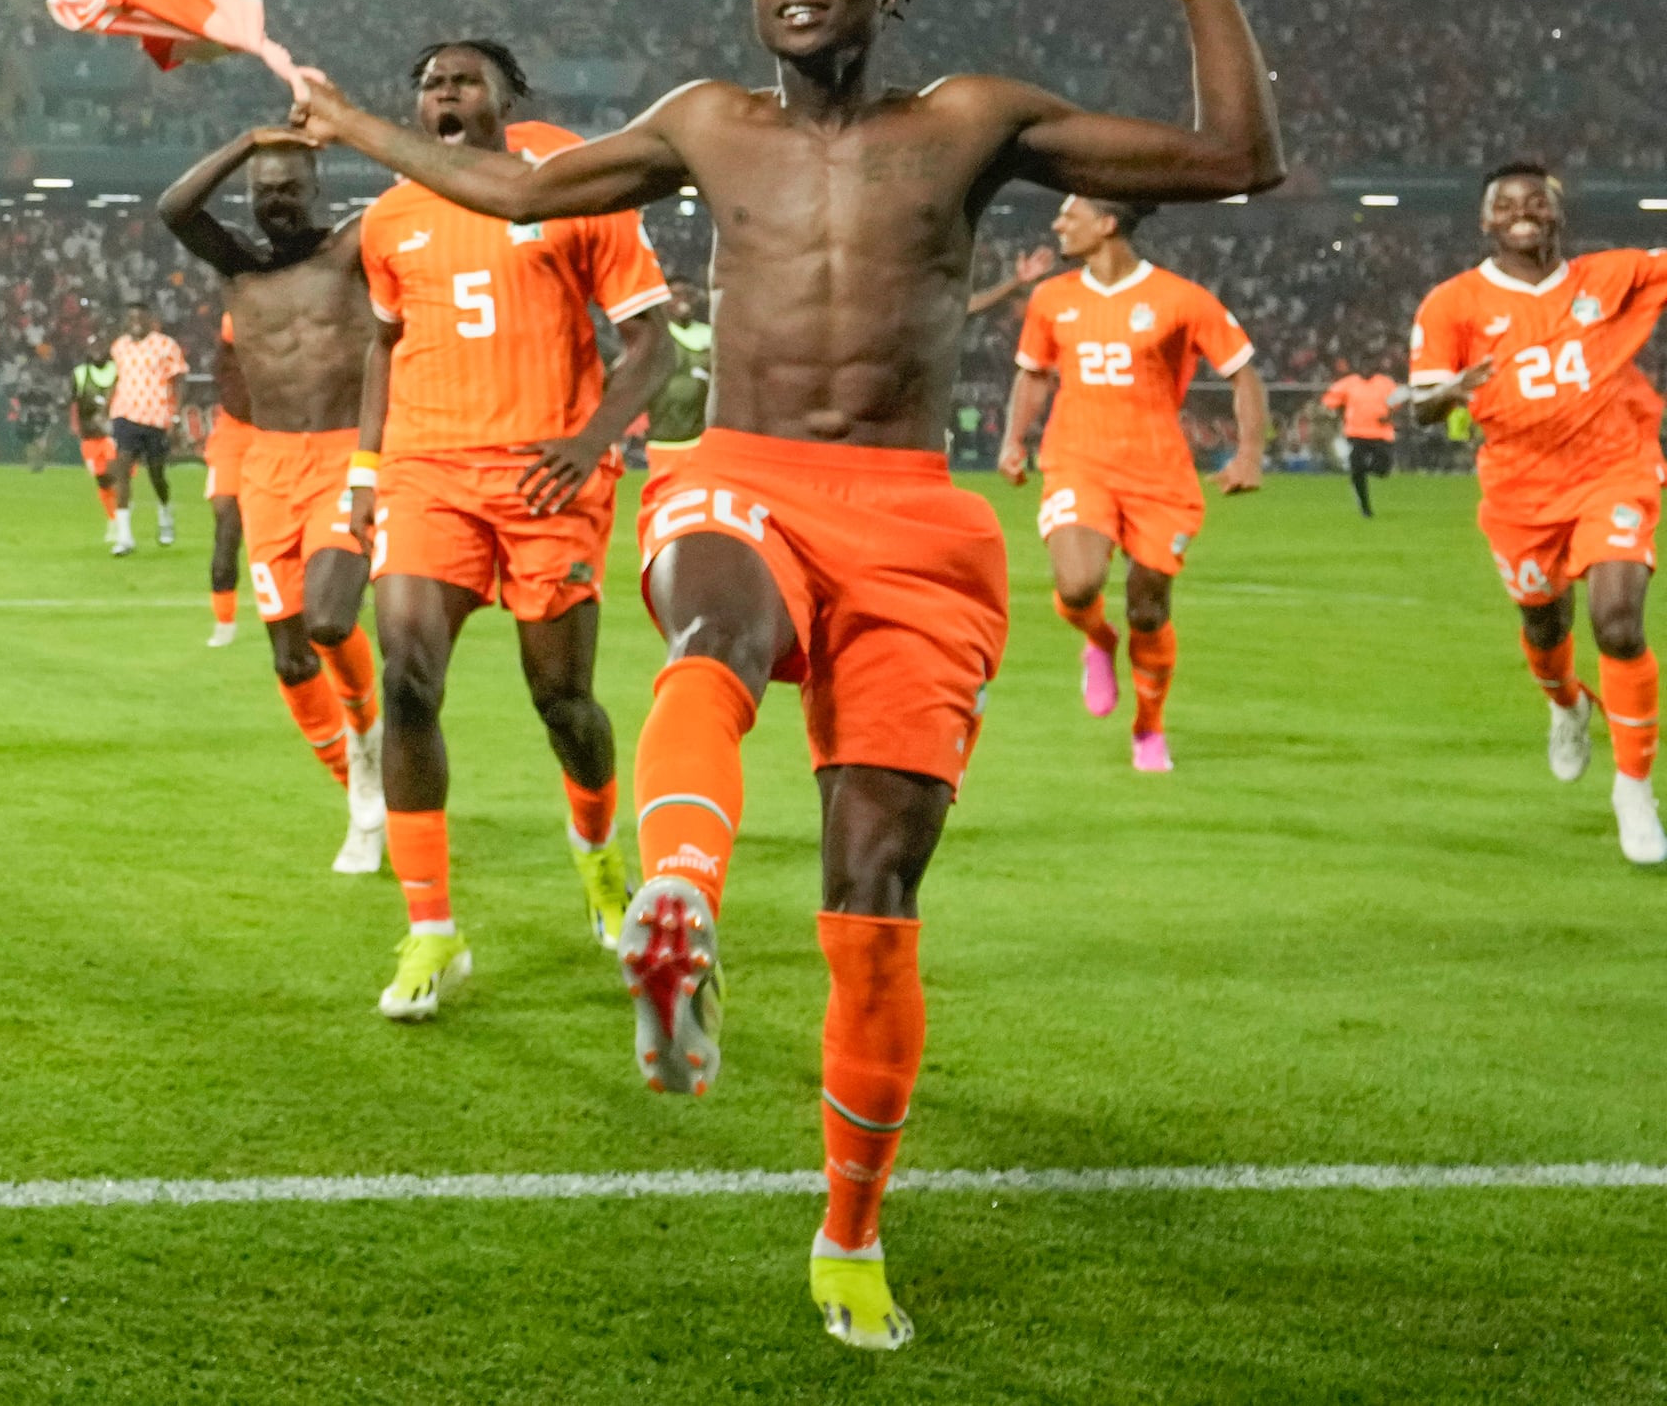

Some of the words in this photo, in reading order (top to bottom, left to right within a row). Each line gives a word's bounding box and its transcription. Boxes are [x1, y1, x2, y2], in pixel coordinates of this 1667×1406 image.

[452, 269, 496, 339] 5
[1076, 341, 1134, 387] 22
[1514, 340, 1591, 400] 24
